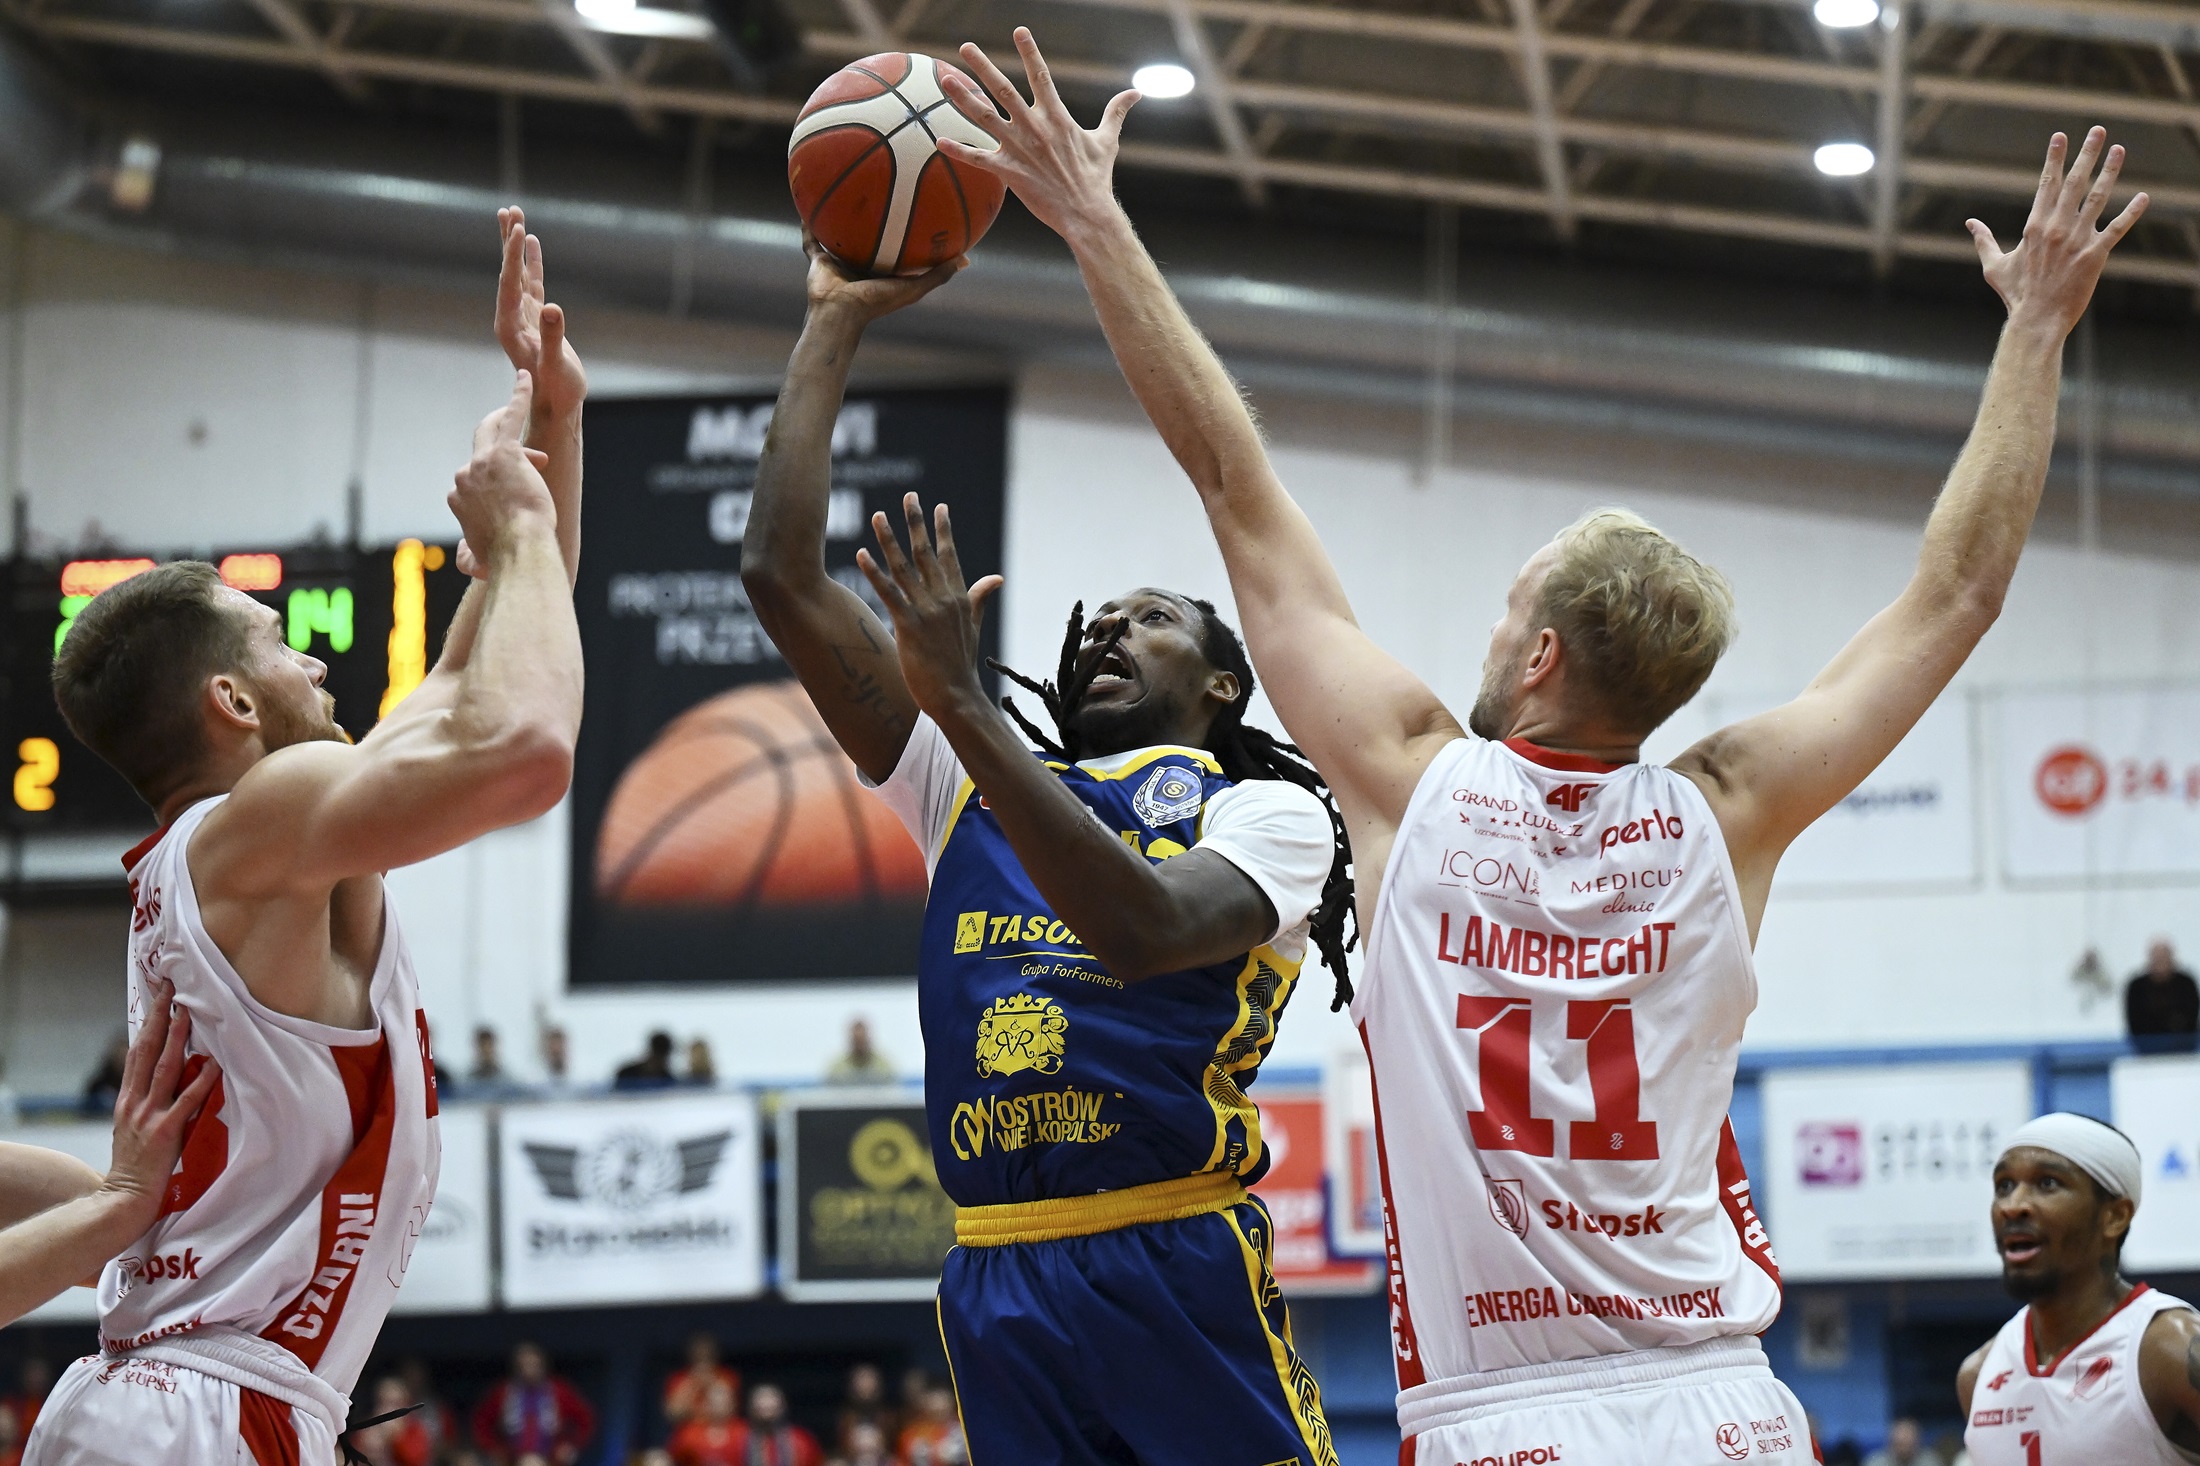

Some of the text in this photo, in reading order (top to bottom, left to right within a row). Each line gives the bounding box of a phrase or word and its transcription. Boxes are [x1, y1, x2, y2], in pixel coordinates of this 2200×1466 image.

[14, 737, 60, 811] 2
[1453, 788, 1518, 812] GRAND
[1546, 783, 1599, 812] 4F
[1440, 848, 1531, 894] ICON
[1571, 865, 1683, 893] MEDICUS
[1602, 891, 1655, 914] clinic
[1437, 912, 1676, 980] LAMBRECHT
[1021, 962, 1125, 990] Grupa ForFarmers
[1456, 993, 1660, 1161] 11
[995, 1085, 1105, 1130] OSTRÓW
[1541, 1200, 1666, 1242] Słupsk
[282, 1192, 374, 1340] CZARNI
[1465, 1286, 1560, 1328] ENERGA
